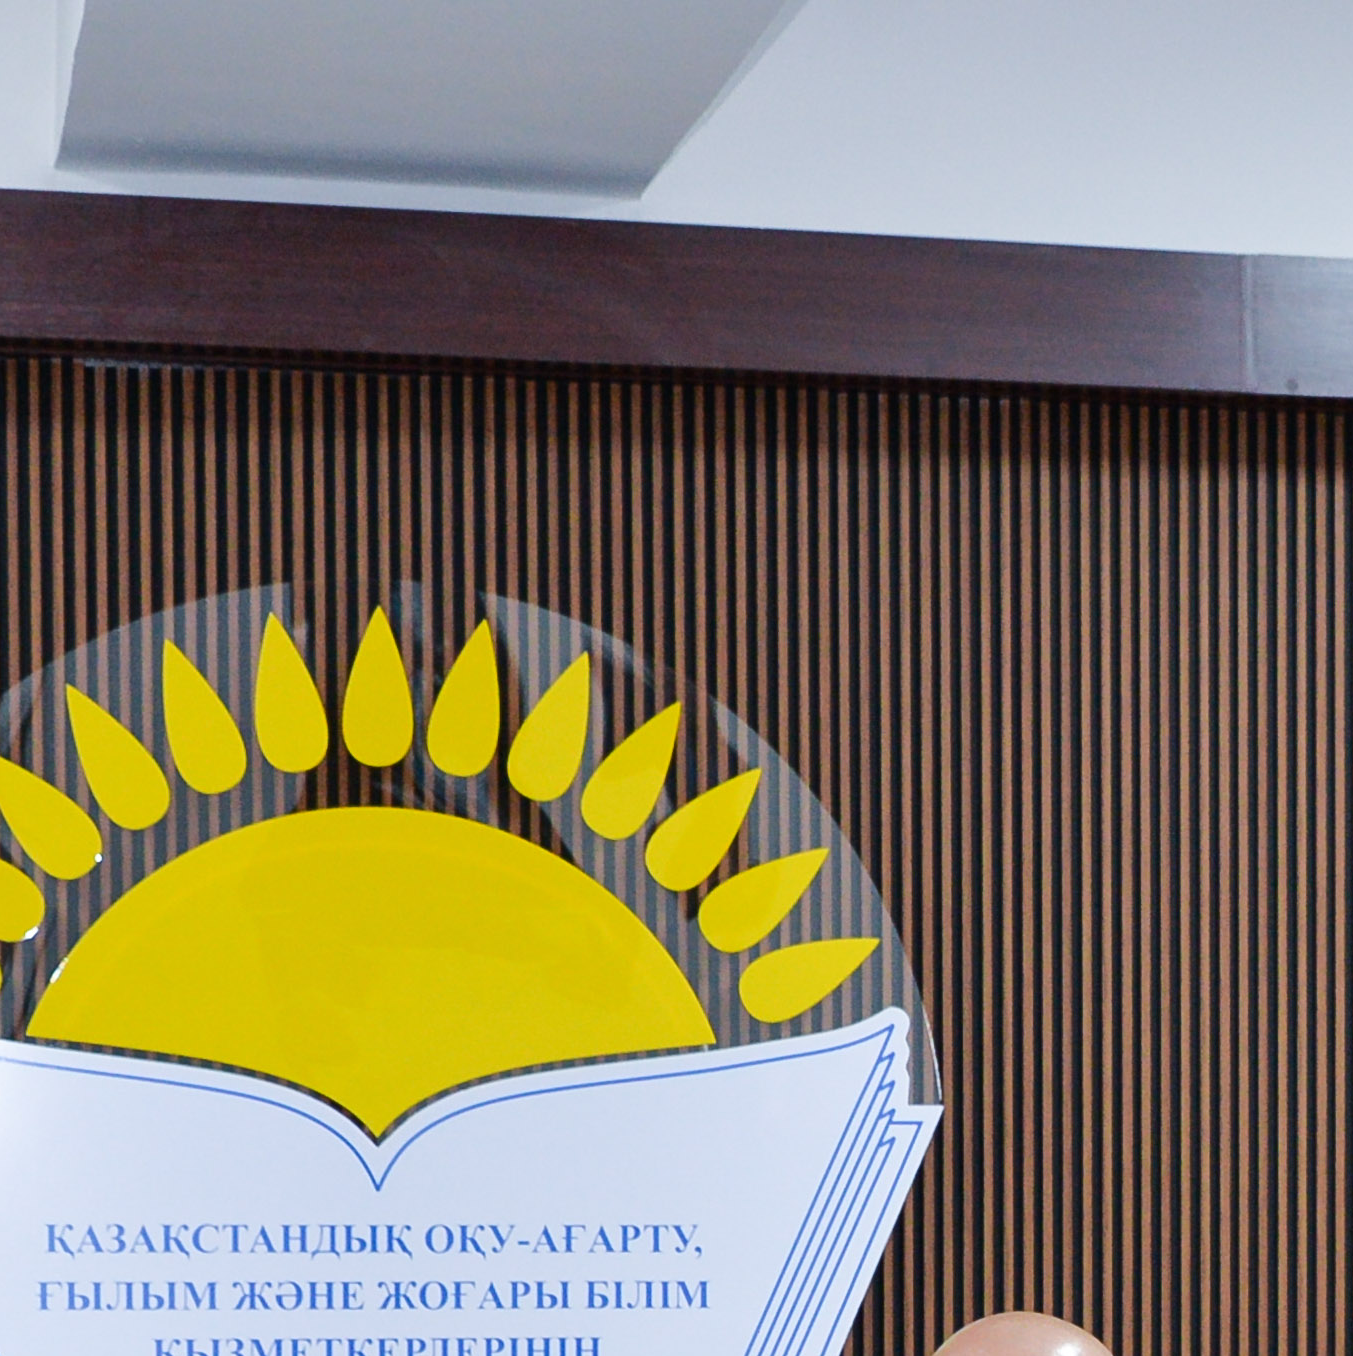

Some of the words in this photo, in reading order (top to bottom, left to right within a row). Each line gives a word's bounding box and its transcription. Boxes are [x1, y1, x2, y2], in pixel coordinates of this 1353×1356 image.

[45, 1223, 413, 1260] ҚАЗАҚСТАНДЫҚ
[424, 1223, 703, 1260] ОҚУ-АҒАРТУ,
[36, 1280, 220, 1311] ҒЫЛЫМ
[232, 1280, 365, 1311] ЖӘНЕ
[377, 1280, 570, 1311] ЖОҒАРЫ
[585, 1279, 710, 1310] БІЛІМ
